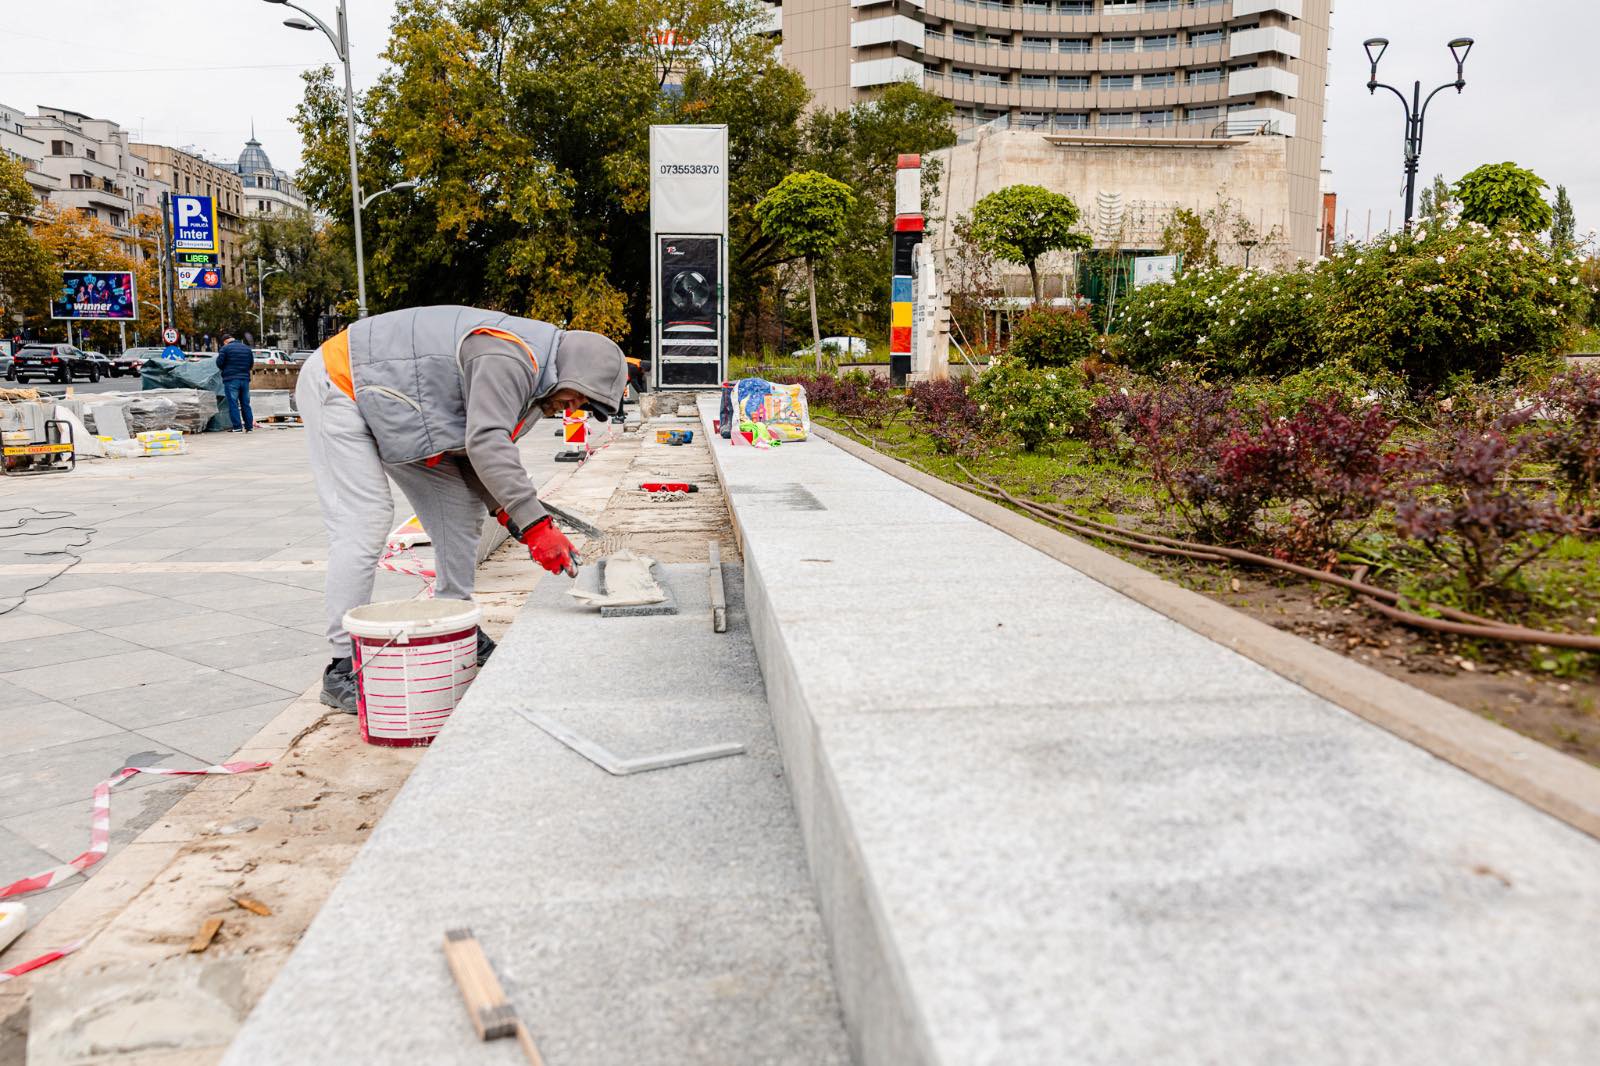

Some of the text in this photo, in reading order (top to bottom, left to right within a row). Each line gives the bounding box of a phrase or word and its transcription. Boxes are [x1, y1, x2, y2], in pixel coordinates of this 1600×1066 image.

[660, 164, 719, 175] 0735538370
[178, 198, 201, 227] P
[180, 228, 208, 239] Inter
[185, 254, 209, 263] LIBER
[73, 302, 112, 311] winner
